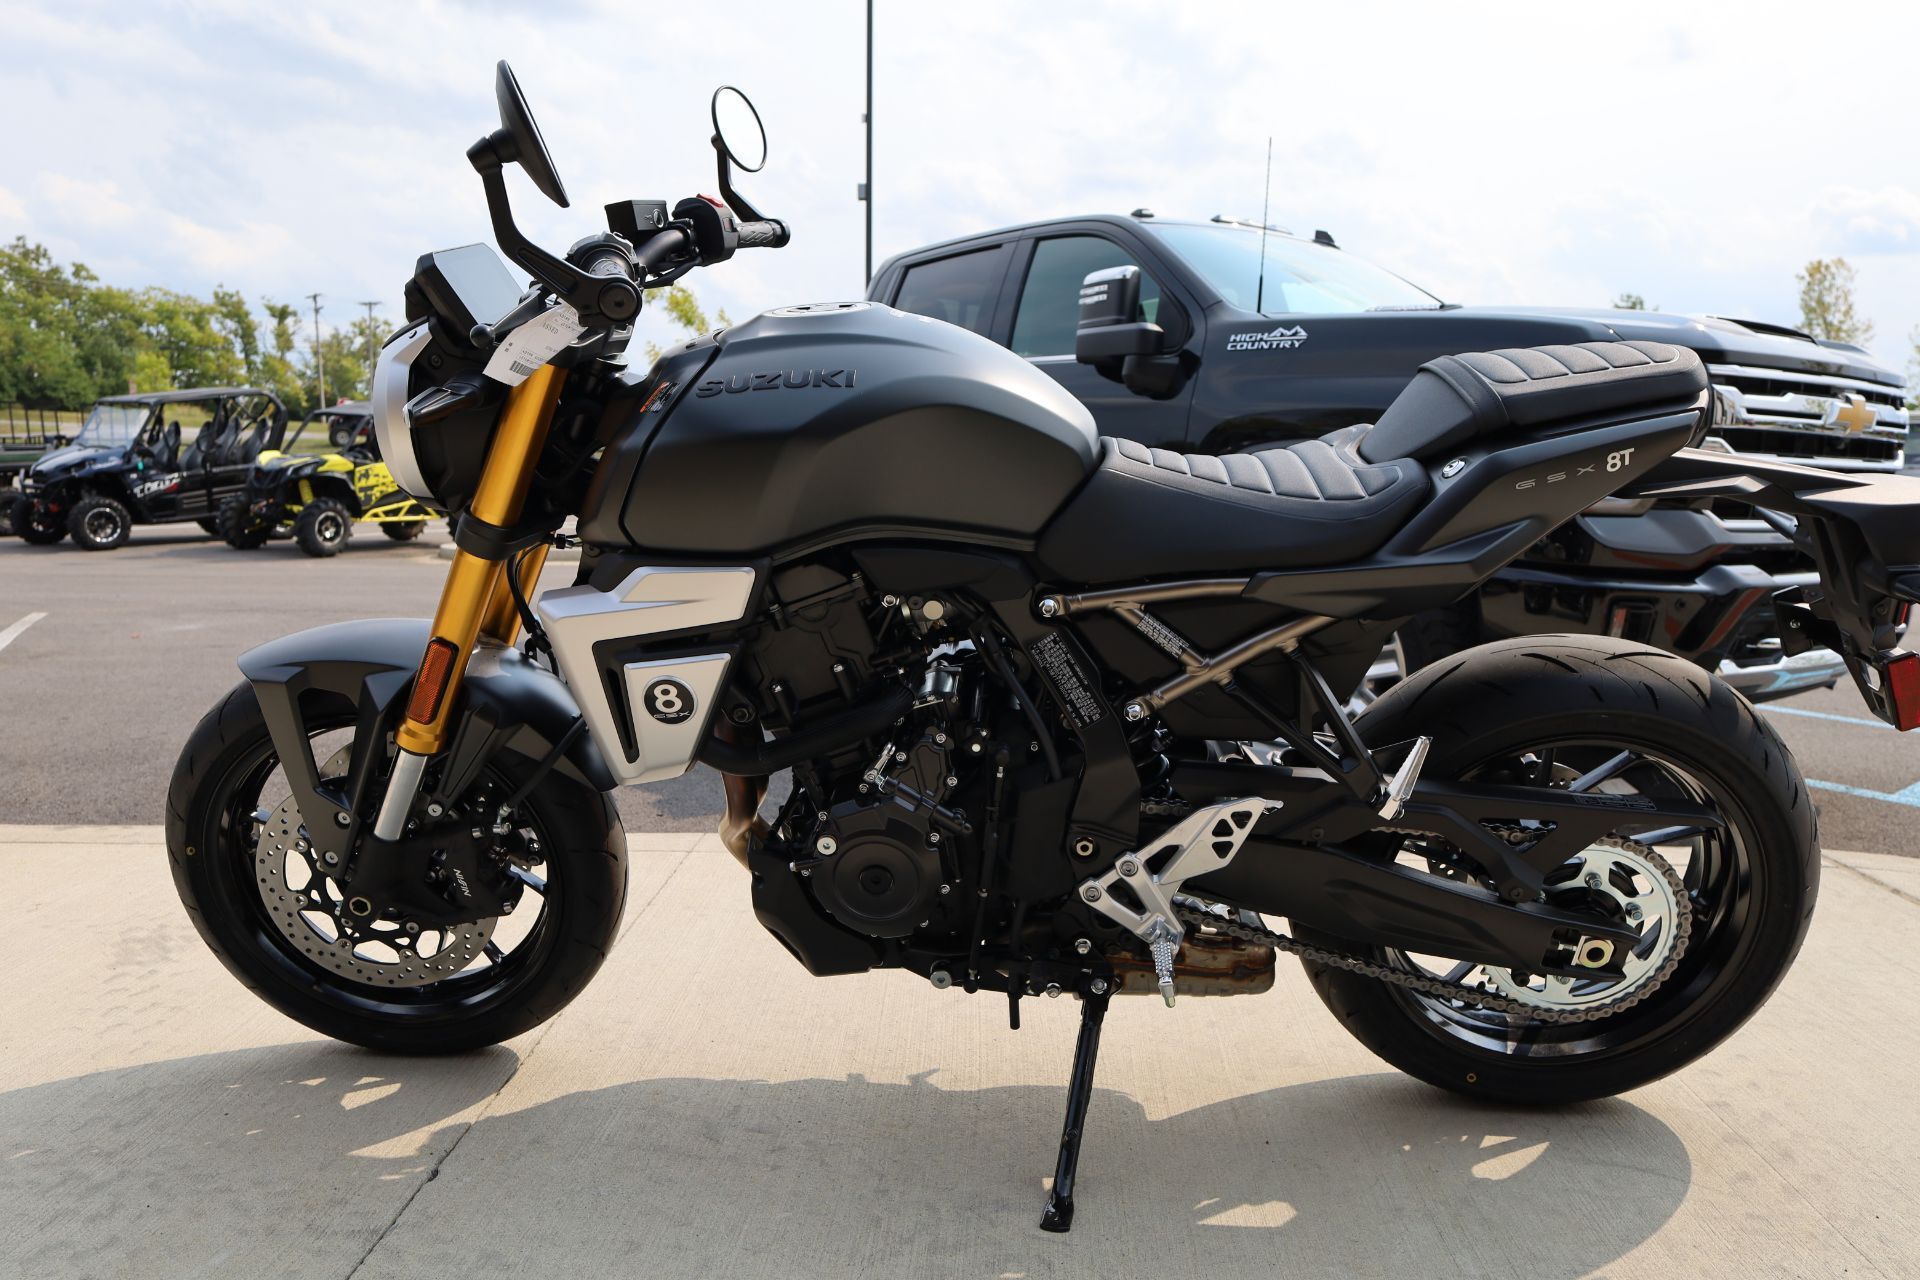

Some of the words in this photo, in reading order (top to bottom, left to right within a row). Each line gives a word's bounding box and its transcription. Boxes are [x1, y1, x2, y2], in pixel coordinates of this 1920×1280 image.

[1226, 340, 1305, 351] COUNTRY
[1229, 332, 1269, 342] HIGH
[695, 369, 857, 399] SUZUKI
[1606, 447, 1635, 473] 8T
[653, 684, 683, 713] 8
